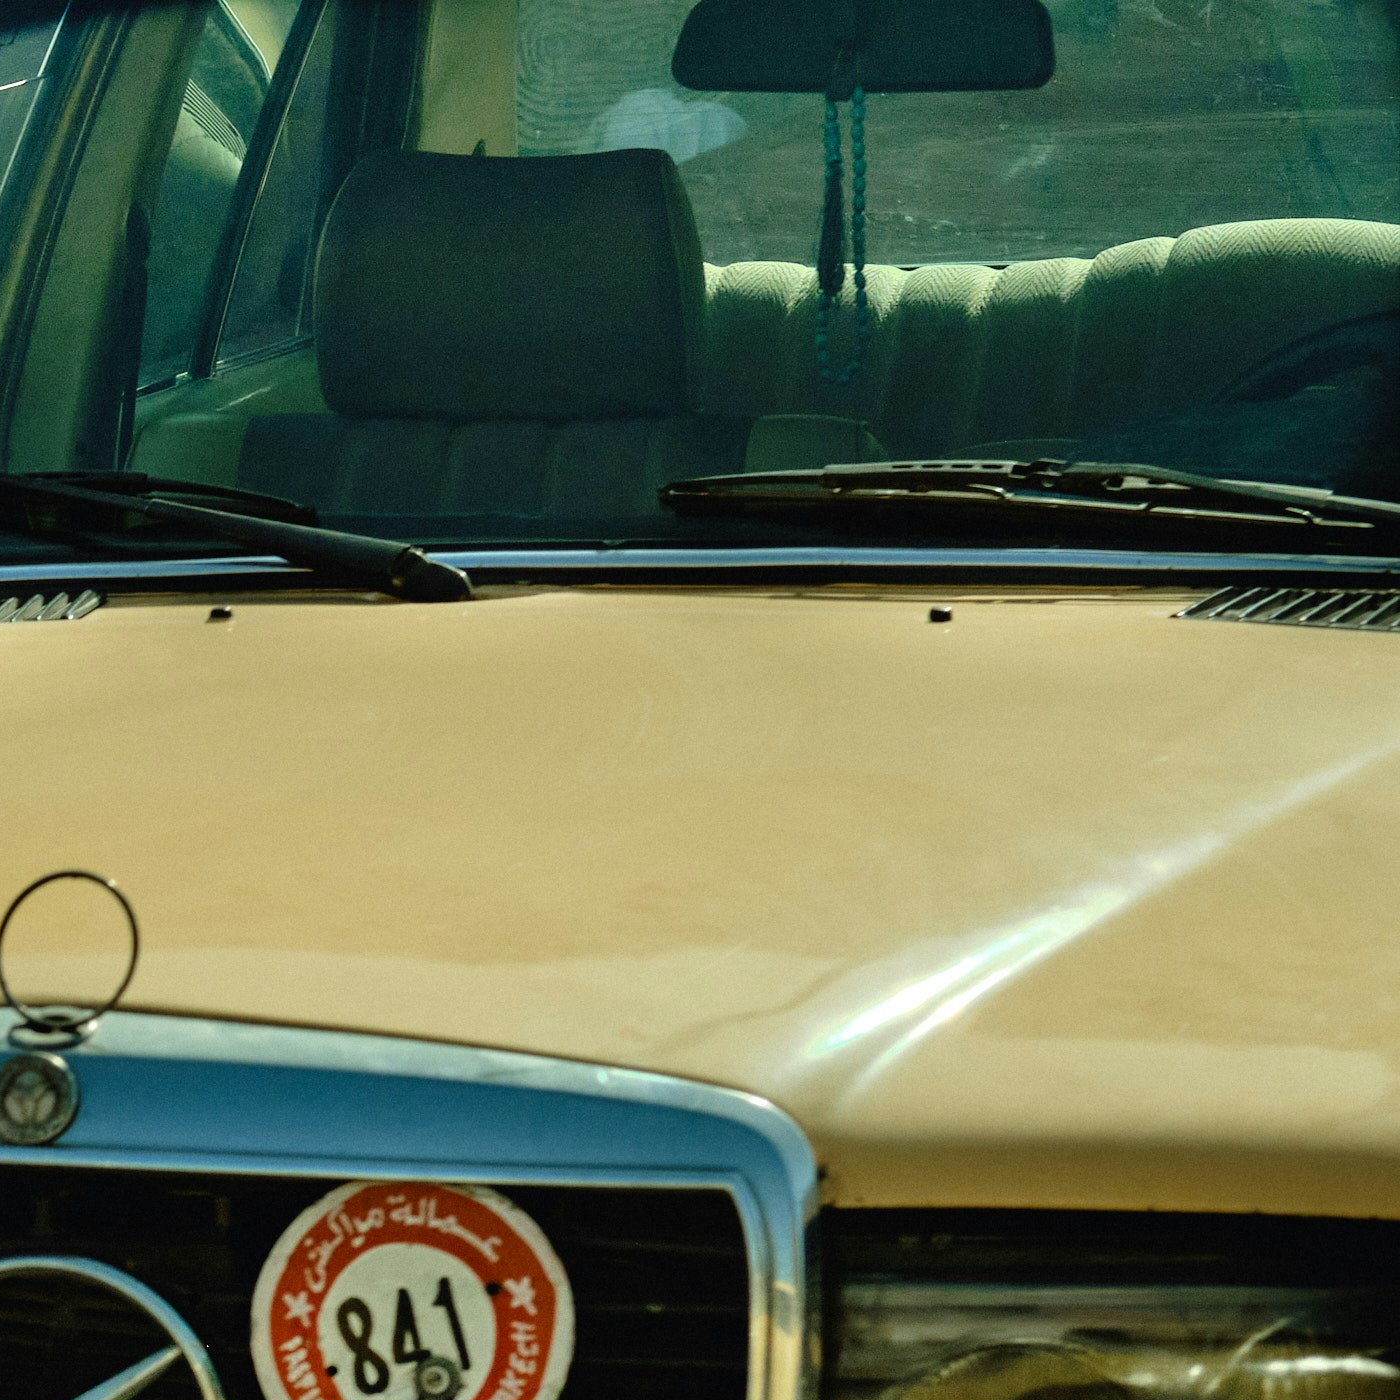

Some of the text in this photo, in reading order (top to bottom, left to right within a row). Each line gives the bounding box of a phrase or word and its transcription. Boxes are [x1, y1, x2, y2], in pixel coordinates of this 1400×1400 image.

[303, 1194, 504, 1294] عمالة مراكش
[336, 1275, 471, 1395] 841
